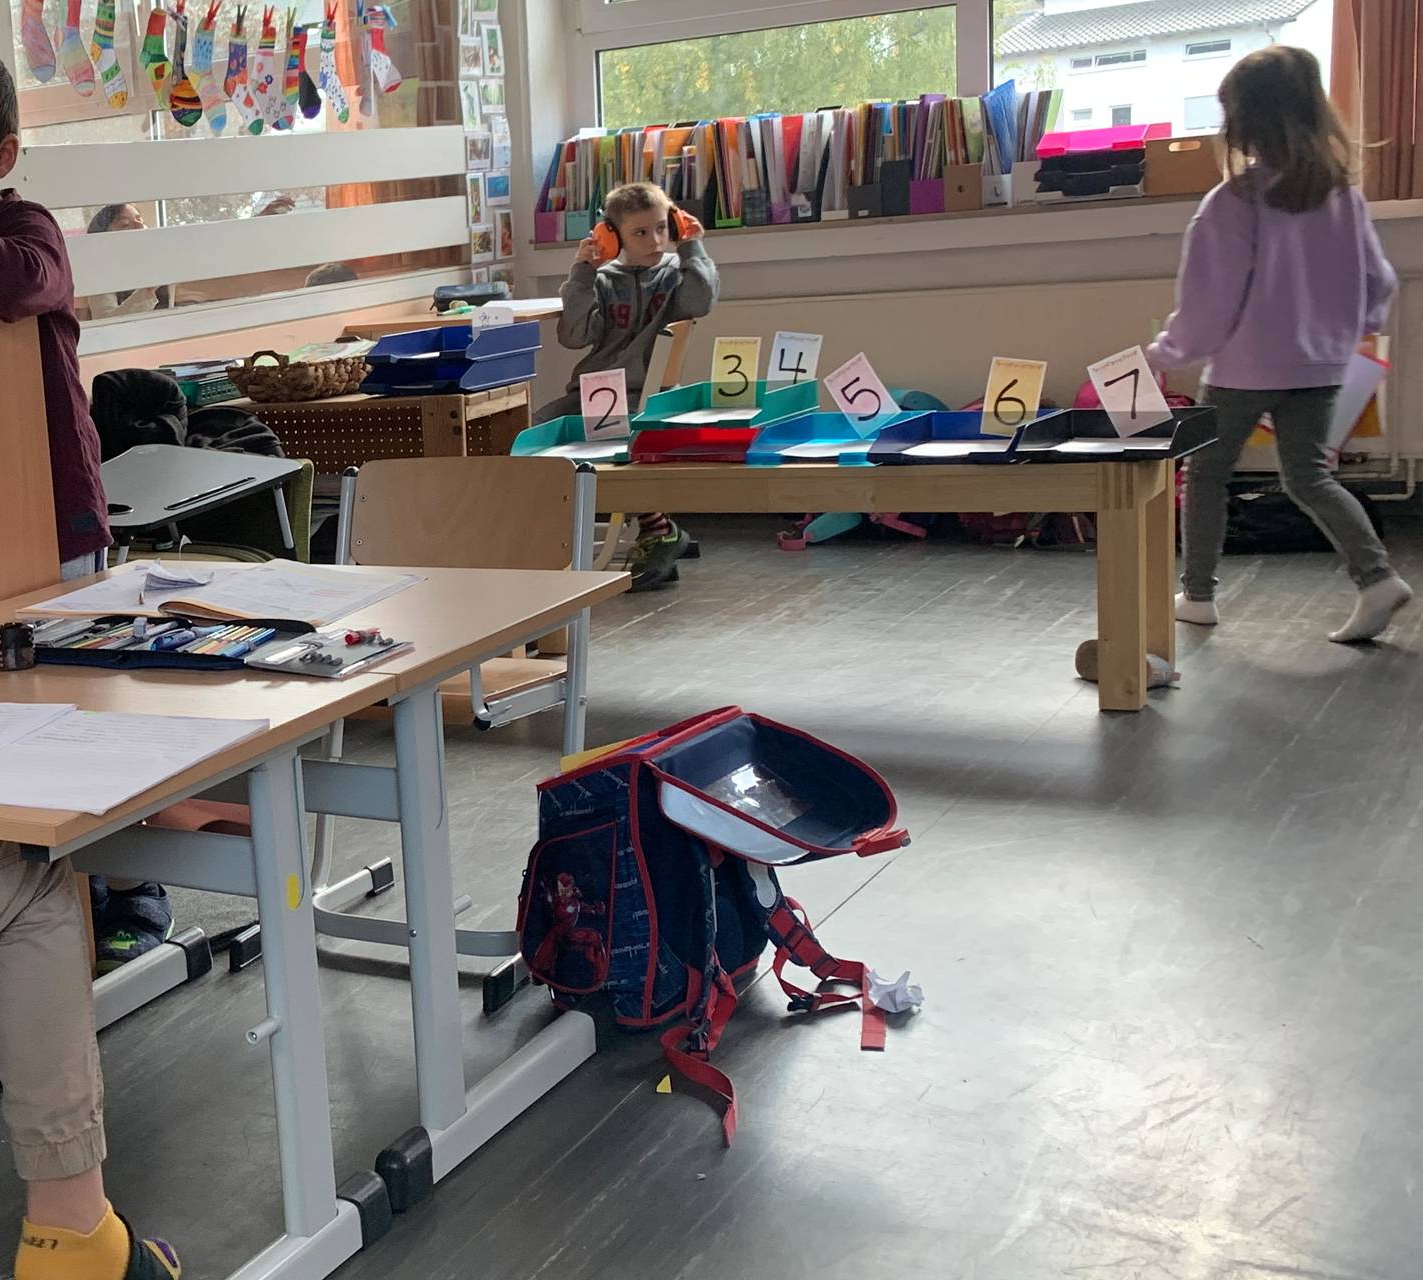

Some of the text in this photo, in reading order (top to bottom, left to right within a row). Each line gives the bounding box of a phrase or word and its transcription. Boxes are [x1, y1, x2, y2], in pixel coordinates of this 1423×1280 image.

[718, 354, 749, 397] 3
[778, 348, 807, 384] 4
[589, 387, 621, 431] 2
[841, 376, 881, 422] 5
[994, 378, 1027, 426] 6
[1104, 368, 1140, 420] 7
